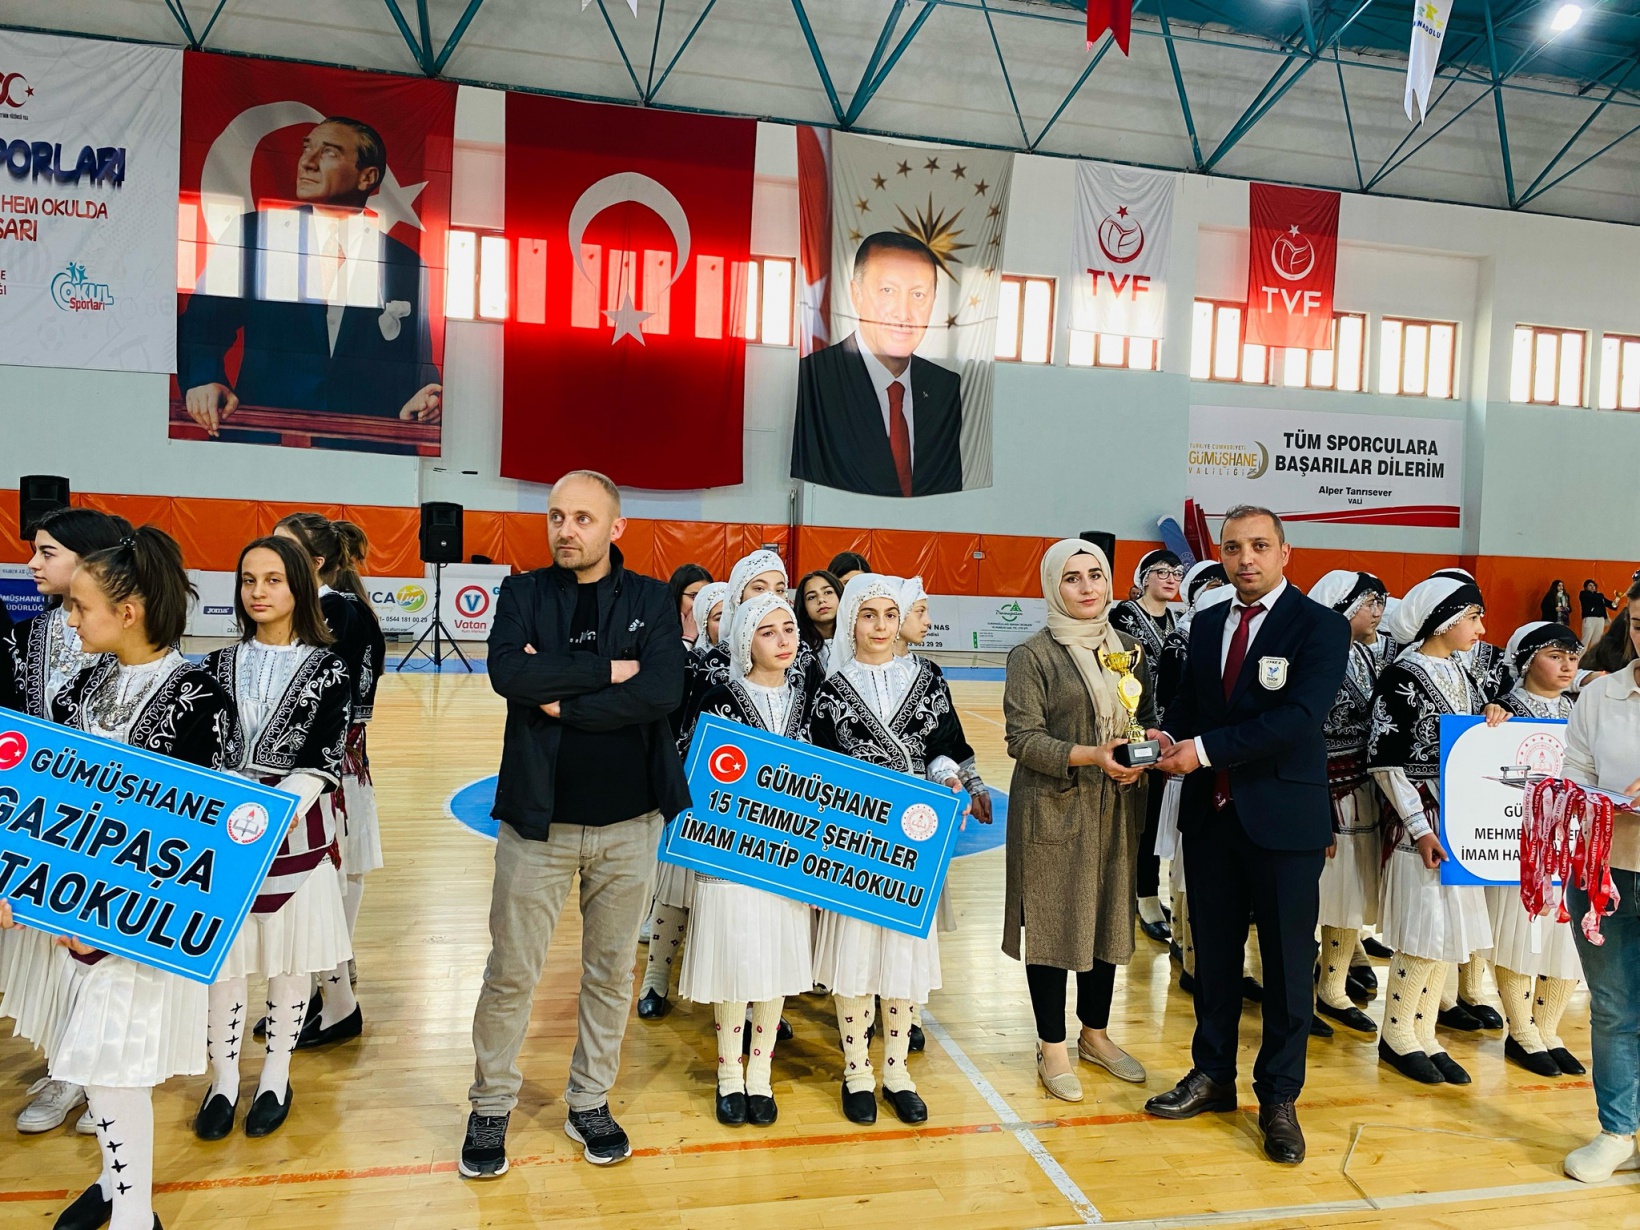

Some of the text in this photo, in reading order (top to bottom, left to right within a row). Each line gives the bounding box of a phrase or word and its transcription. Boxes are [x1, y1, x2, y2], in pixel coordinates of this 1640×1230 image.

[2, 195, 108, 219] HEM OKULDA
[1086, 268, 1151, 301] TVF
[1261, 286, 1322, 317] TVF
[1283, 429, 1438, 456] TÜM SPORCULARA
[1275, 455, 1444, 478] BAŞARILAR DİLERİM
[1318, 486, 1392, 497] Alper Tanrısever
[367, 591, 396, 604] CA
[454, 619, 487, 629] Vatan
[30, 747, 226, 826] GÜMÜŞHANE
[756, 764, 892, 824] GÜMÜŞHANE
[708, 790, 918, 871] 15 TEMMUZ ŞEHİTLER
[680, 812, 924, 908] İMAM HATİP ORTAOKULU
[1461, 846, 1500, 861] İMAM
